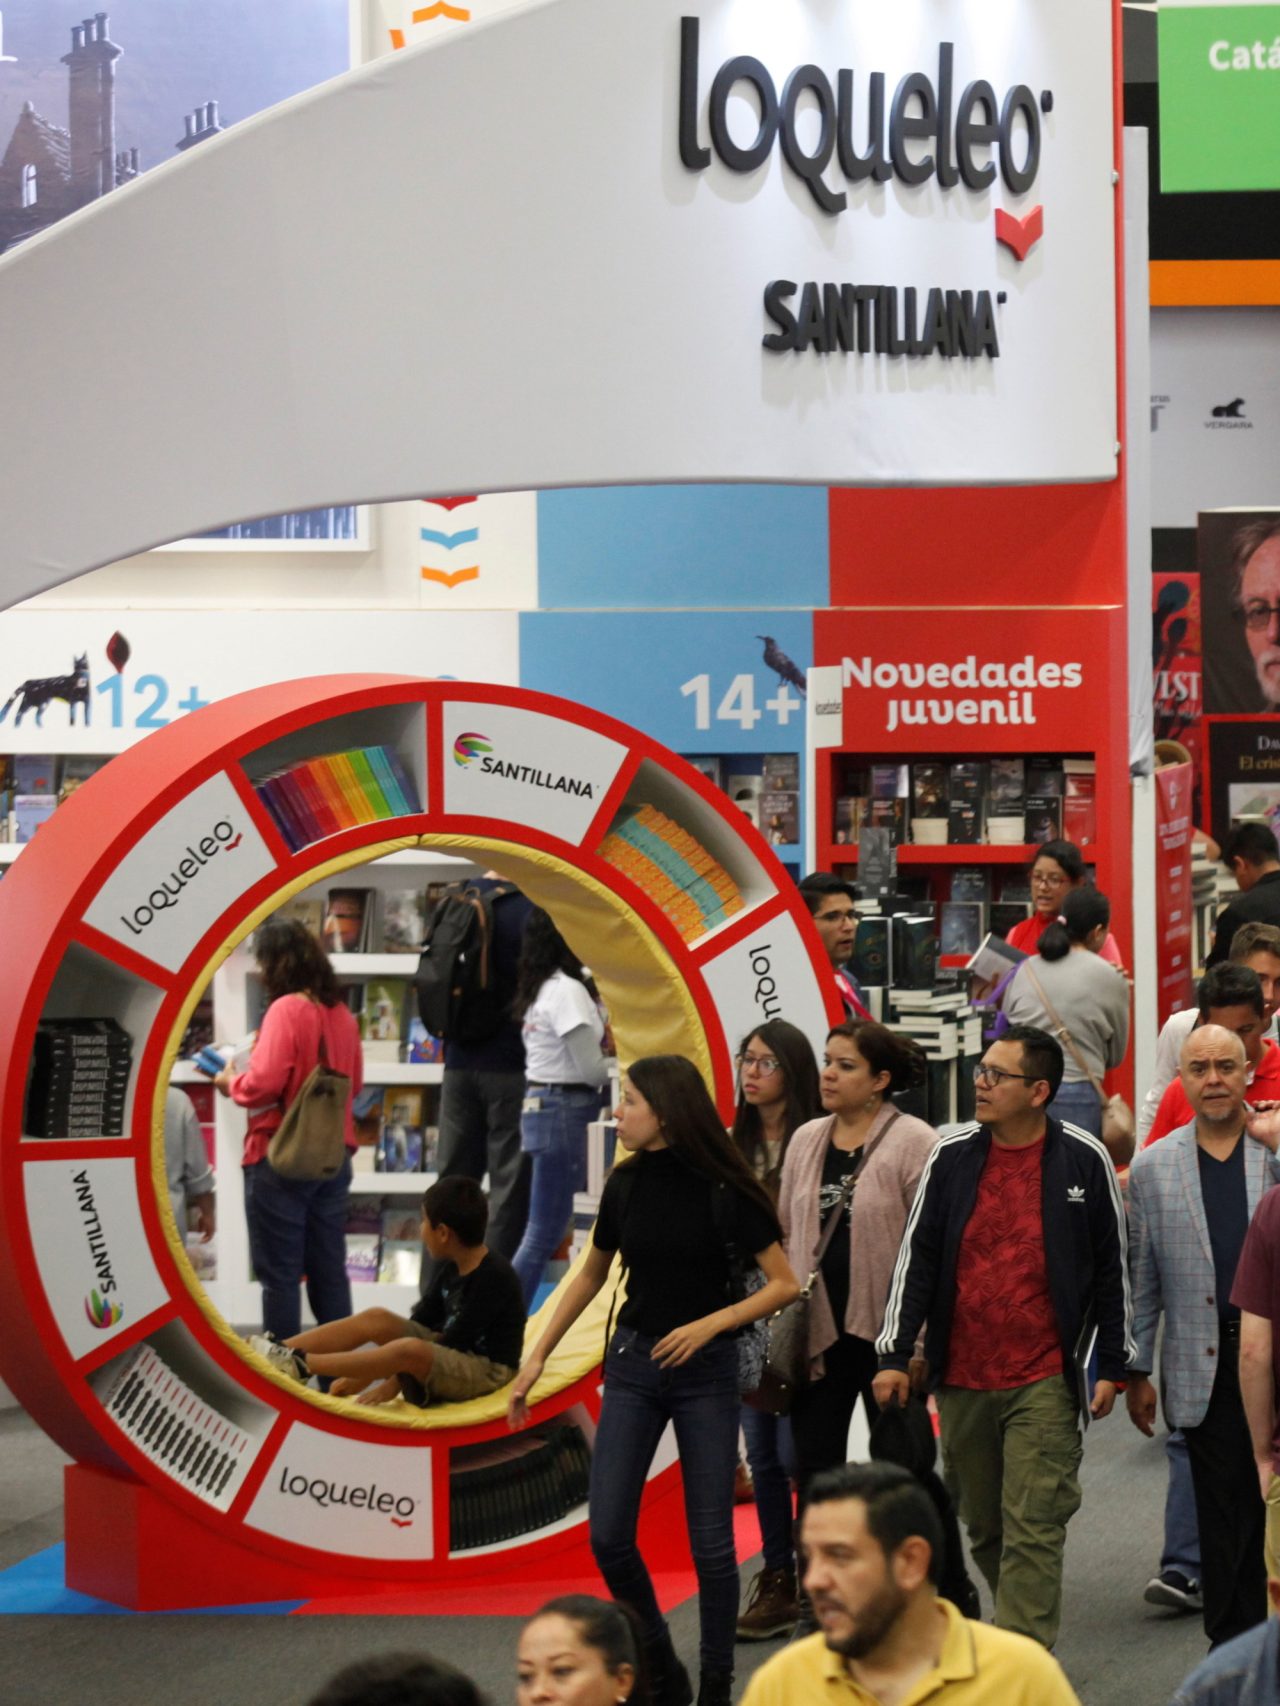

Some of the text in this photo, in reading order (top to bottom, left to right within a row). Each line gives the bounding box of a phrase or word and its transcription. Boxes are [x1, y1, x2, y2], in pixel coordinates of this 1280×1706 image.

[761, 279, 1000, 358] SANTILLANA
[1203, 421, 1254, 430] VERGARA
[841, 655, 1083, 689] Novedades
[679, 672, 801, 731] 14+
[885, 690, 1037, 731] juvenil
[480, 756, 593, 800] SANTILLANA
[1239, 755, 1254, 770] El
[72, 1169, 118, 1295] SANTILLANA
